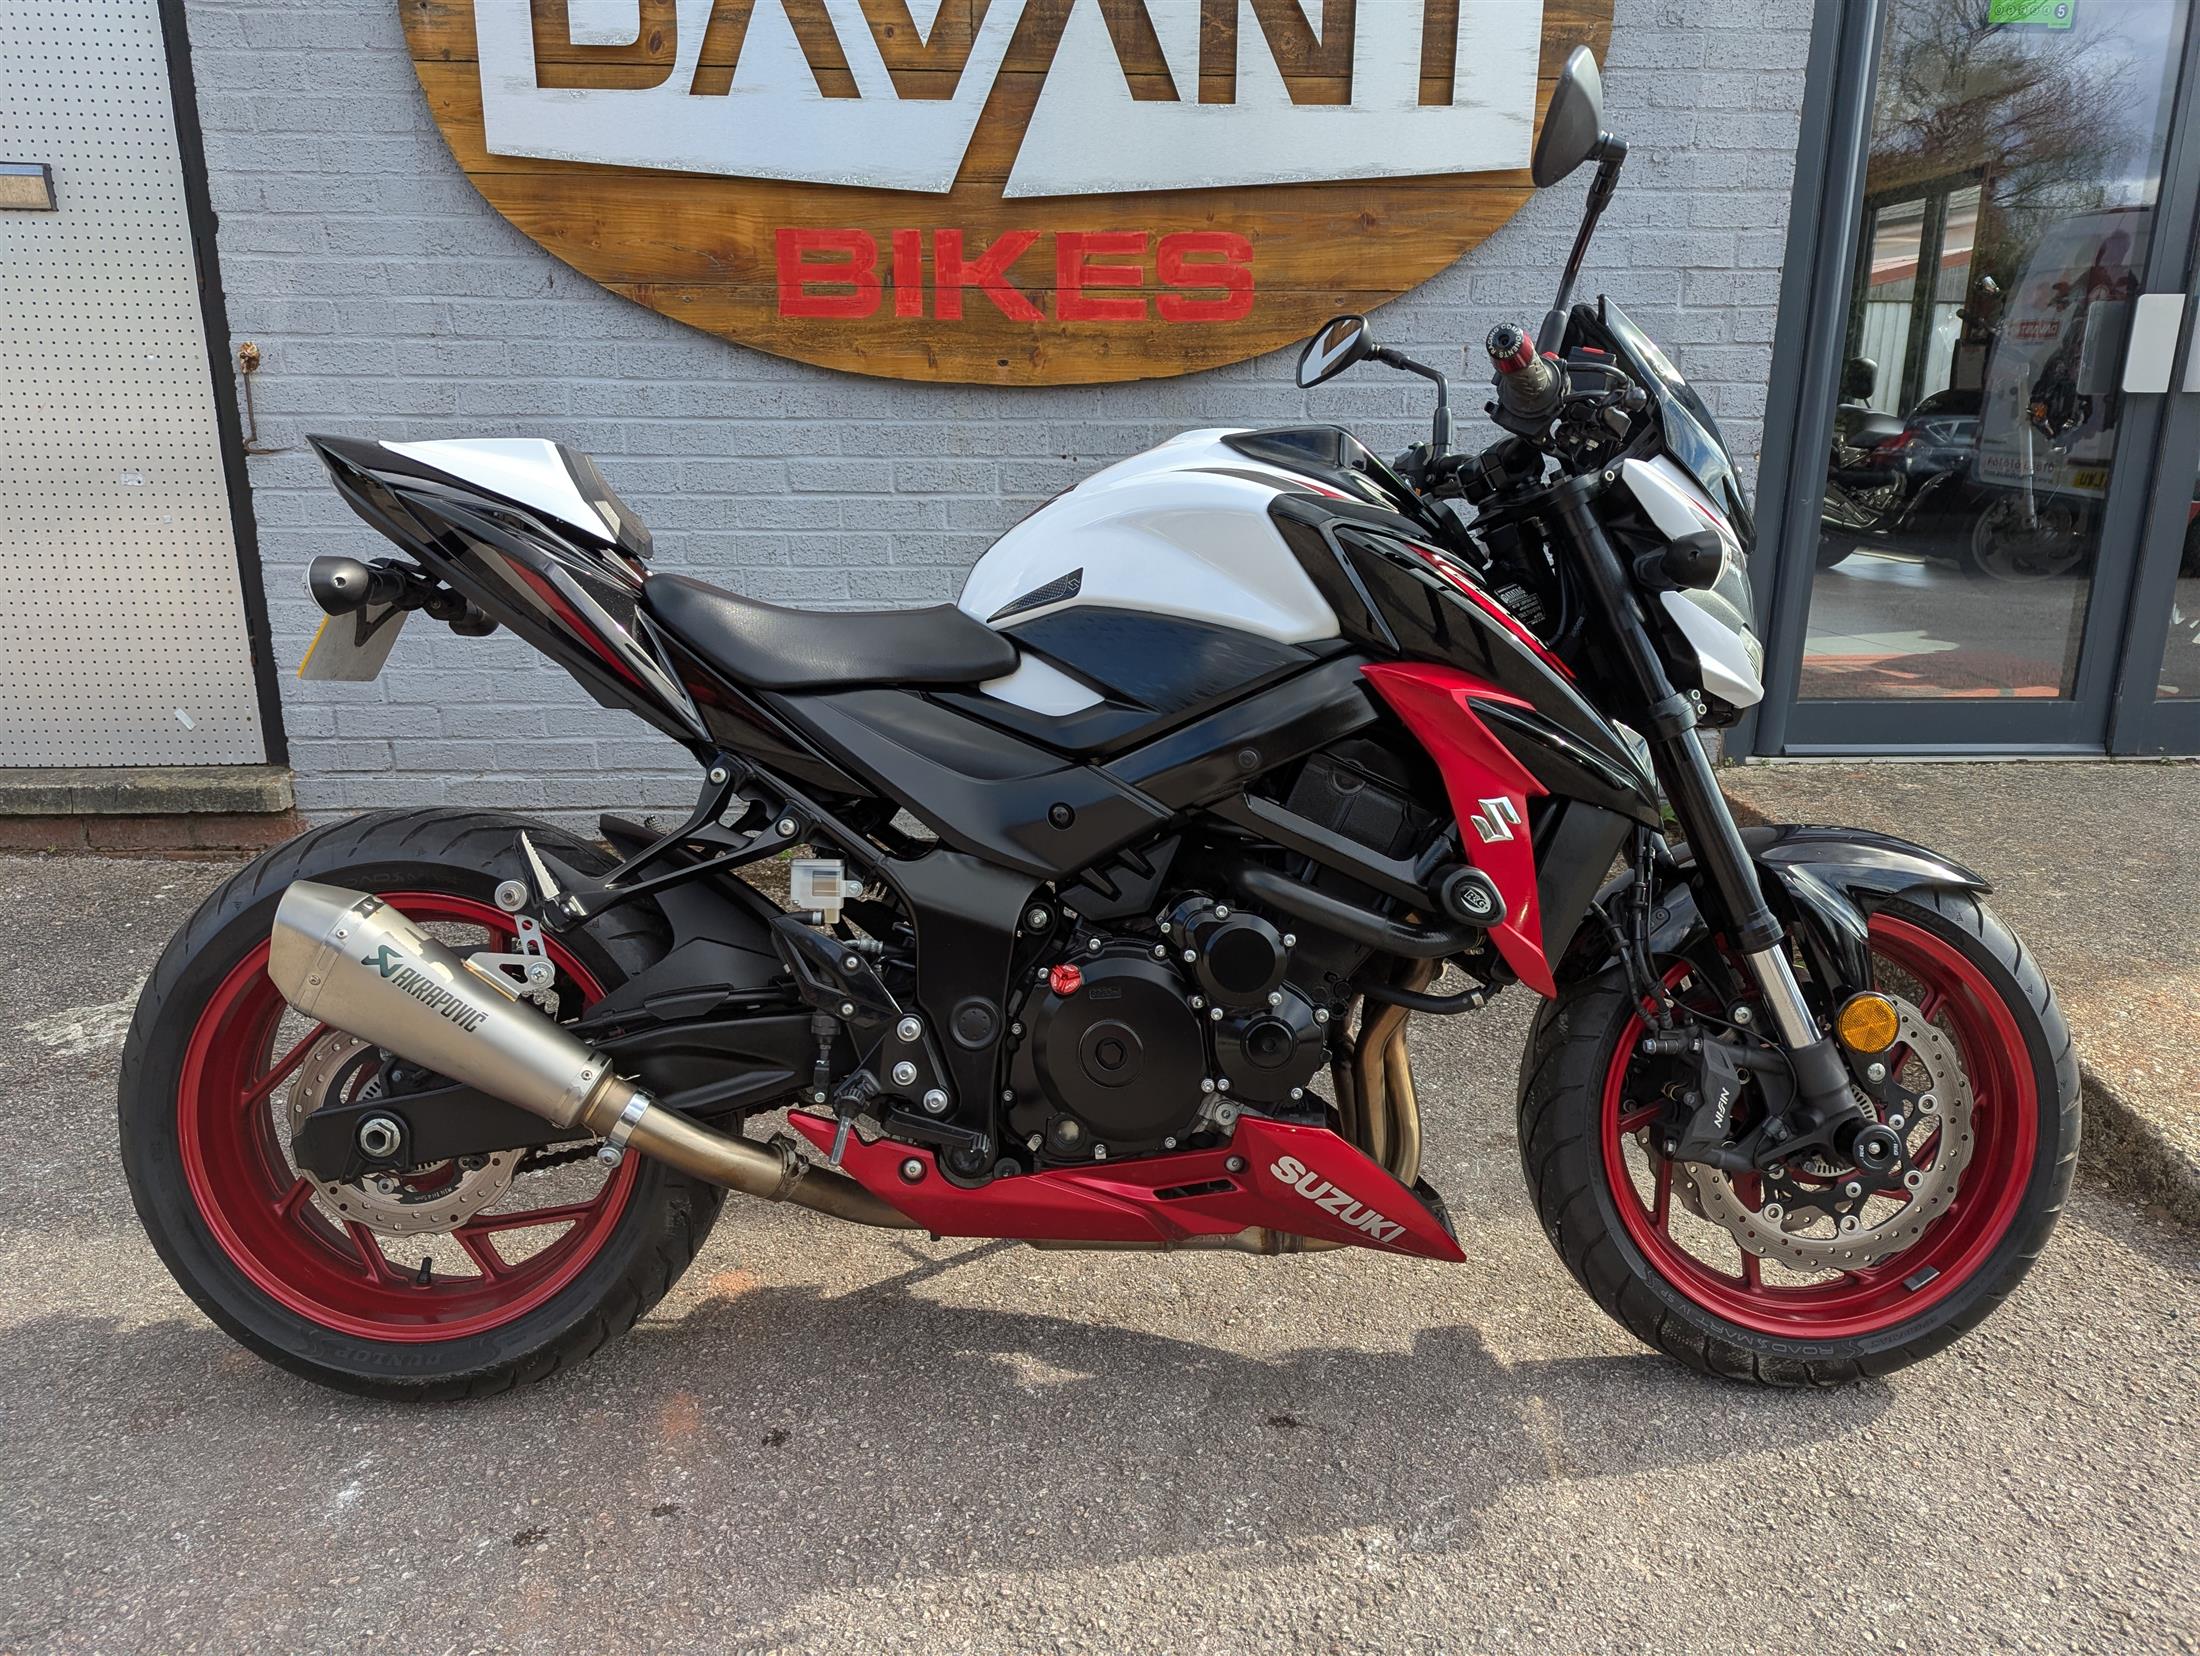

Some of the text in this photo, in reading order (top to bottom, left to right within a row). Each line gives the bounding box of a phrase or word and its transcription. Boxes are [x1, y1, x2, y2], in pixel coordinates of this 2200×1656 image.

[2057, 4, 2066, 17] 5
[775, 228, 1255, 321] BIKES
[1499, 323, 1523, 359] COMPONENTS
[1713, 1087, 1730, 1129] NISSIN
[1270, 1155, 1407, 1243] SUZUKI
